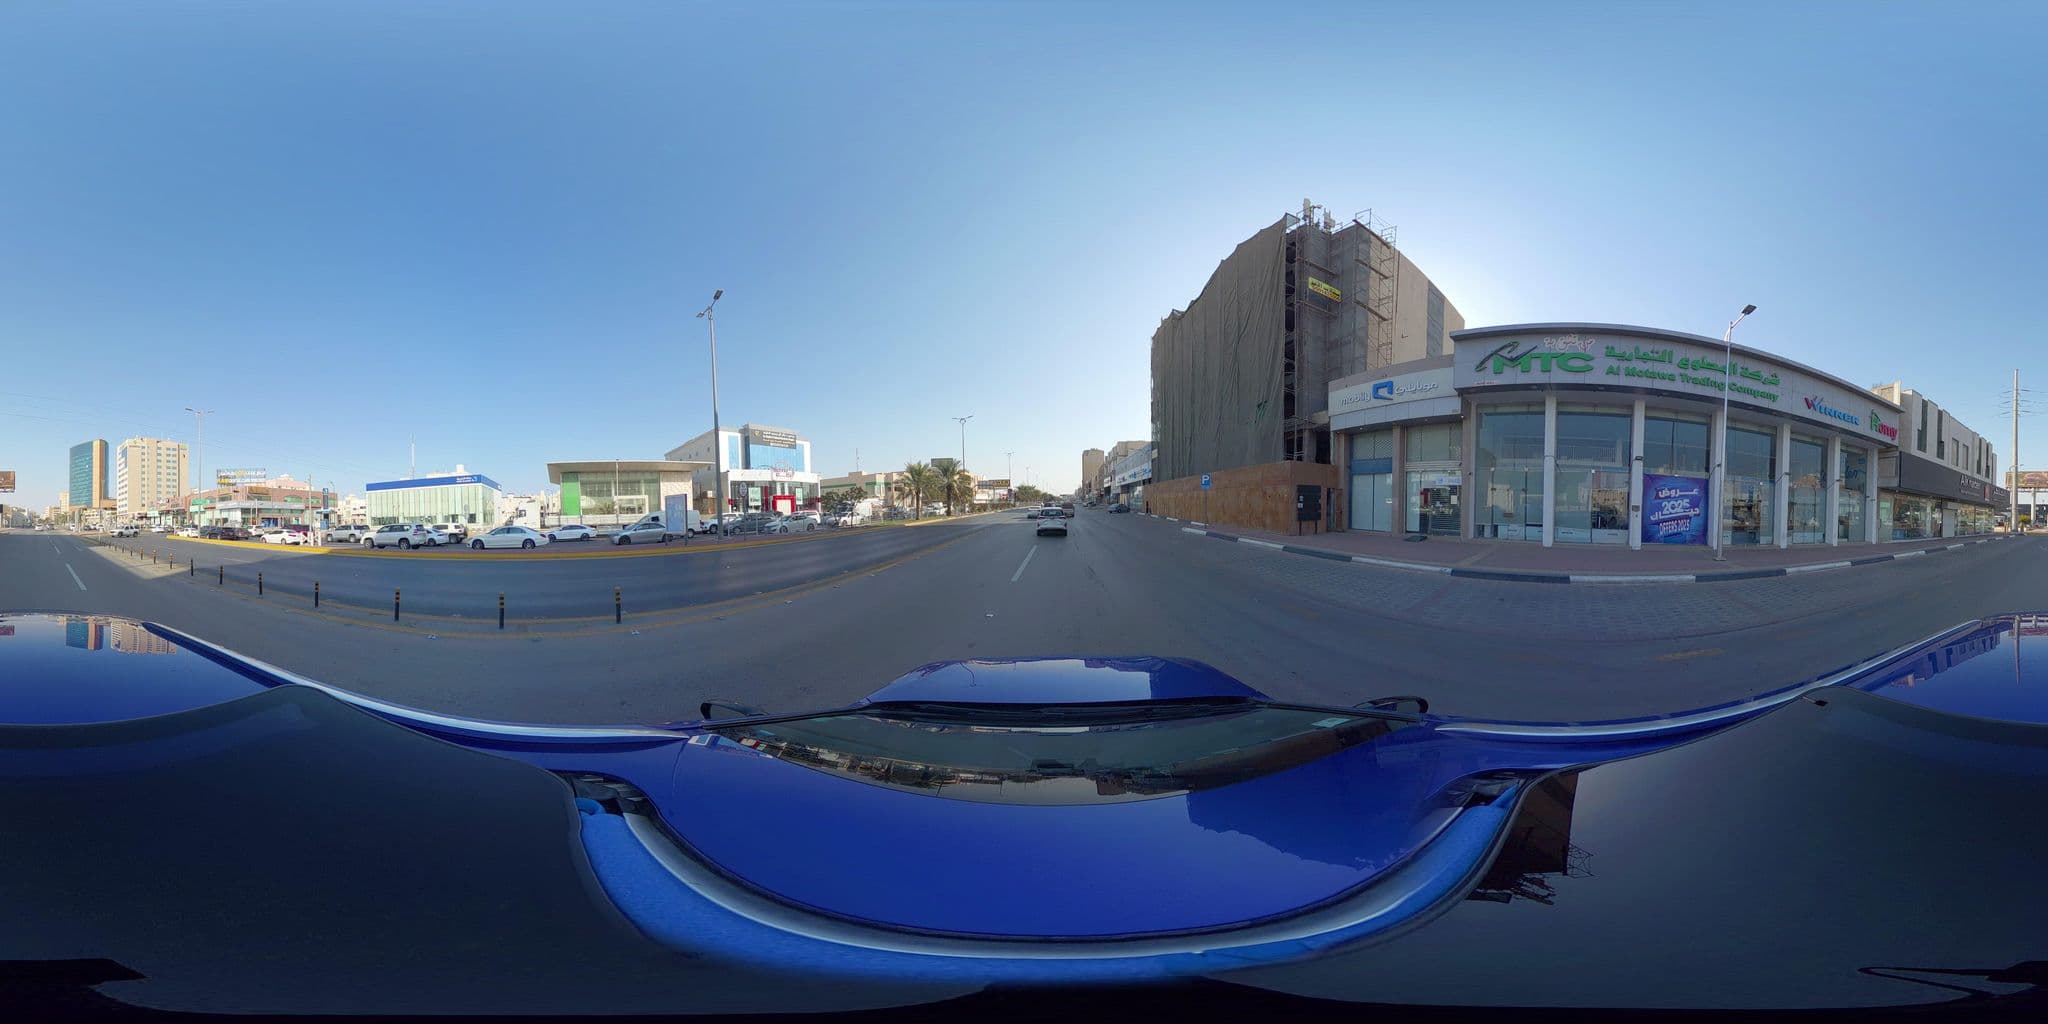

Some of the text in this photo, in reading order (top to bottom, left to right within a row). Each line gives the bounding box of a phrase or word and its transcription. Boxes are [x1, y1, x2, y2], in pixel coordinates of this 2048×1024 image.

[1493, 352, 1594, 374] MTC
[1605, 345, 1673, 364] التجارية
[1605, 365, 1620, 376] Al
[1679, 372, 1726, 391] Trading
[1728, 382, 1779, 402] Company
[1740, 366, 1780, 386] شركة
[1394, 380, 1439, 396] موبايلي
[1341, 391, 1371, 407] mobily
[1804, 395, 1860, 426] WINNER
[1870, 409, 1897, 440] Homy
[1658, 487, 1699, 498] عروض
[1662, 499, 1690, 514] 2025
[1659, 519, 1690, 536] OFFERS 2025
